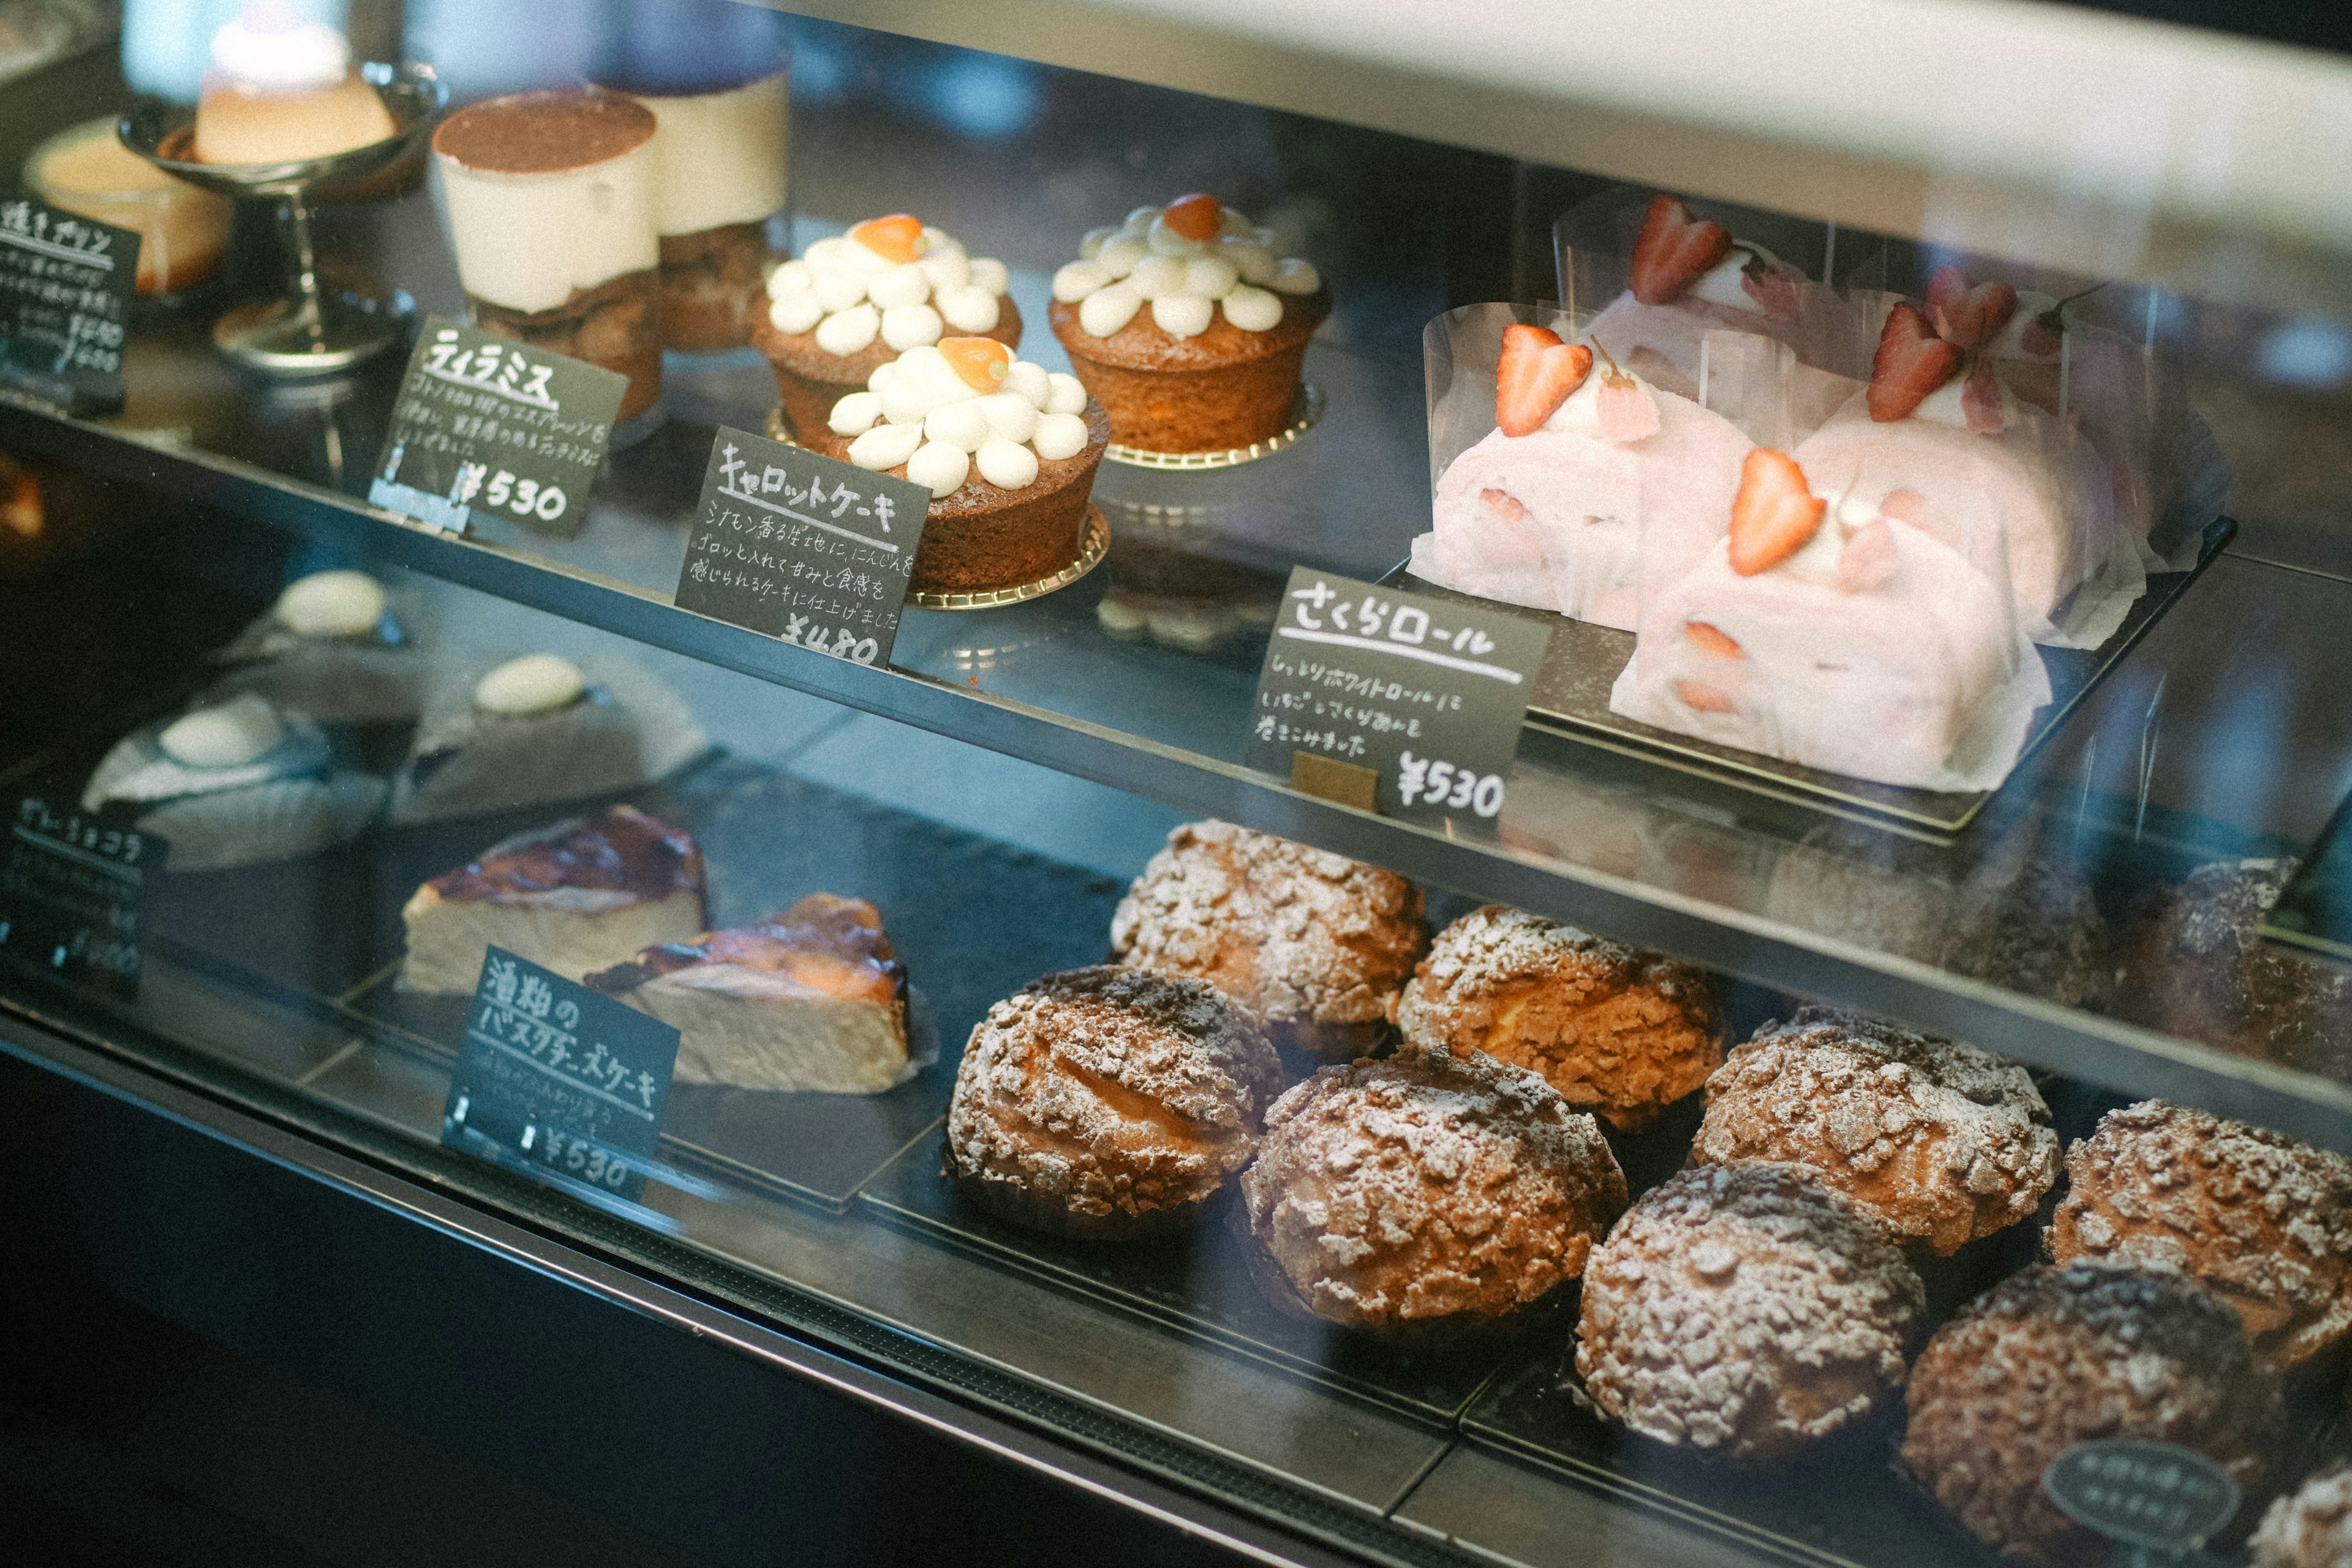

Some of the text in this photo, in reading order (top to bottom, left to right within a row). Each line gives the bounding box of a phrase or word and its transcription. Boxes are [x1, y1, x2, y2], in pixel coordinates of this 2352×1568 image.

[427, 329, 554, 402] ティラミス
[460, 462, 567, 521] ¥530
[719, 442, 897, 533] キャロットケーキ
[697, 533, 885, 600] ゴロッと入れて甘みと食感を
[706, 499, 914, 578] シナモン香る生地に、にんじんを
[690, 558, 899, 630] 感じられるケーキに仕上げました
[1290, 580, 1496, 655] さくらロール
[781, 612, 879, 665] ¥480
[1262, 690, 1422, 739] いちごとさくらあんを
[1271, 654, 1463, 712] しっとりホワイトロールに
[1397, 749, 1506, 818] ¥530
[478, 1006, 657, 1108] バスクチーズケーキ
[545, 1126, 628, 1188] ¥530
